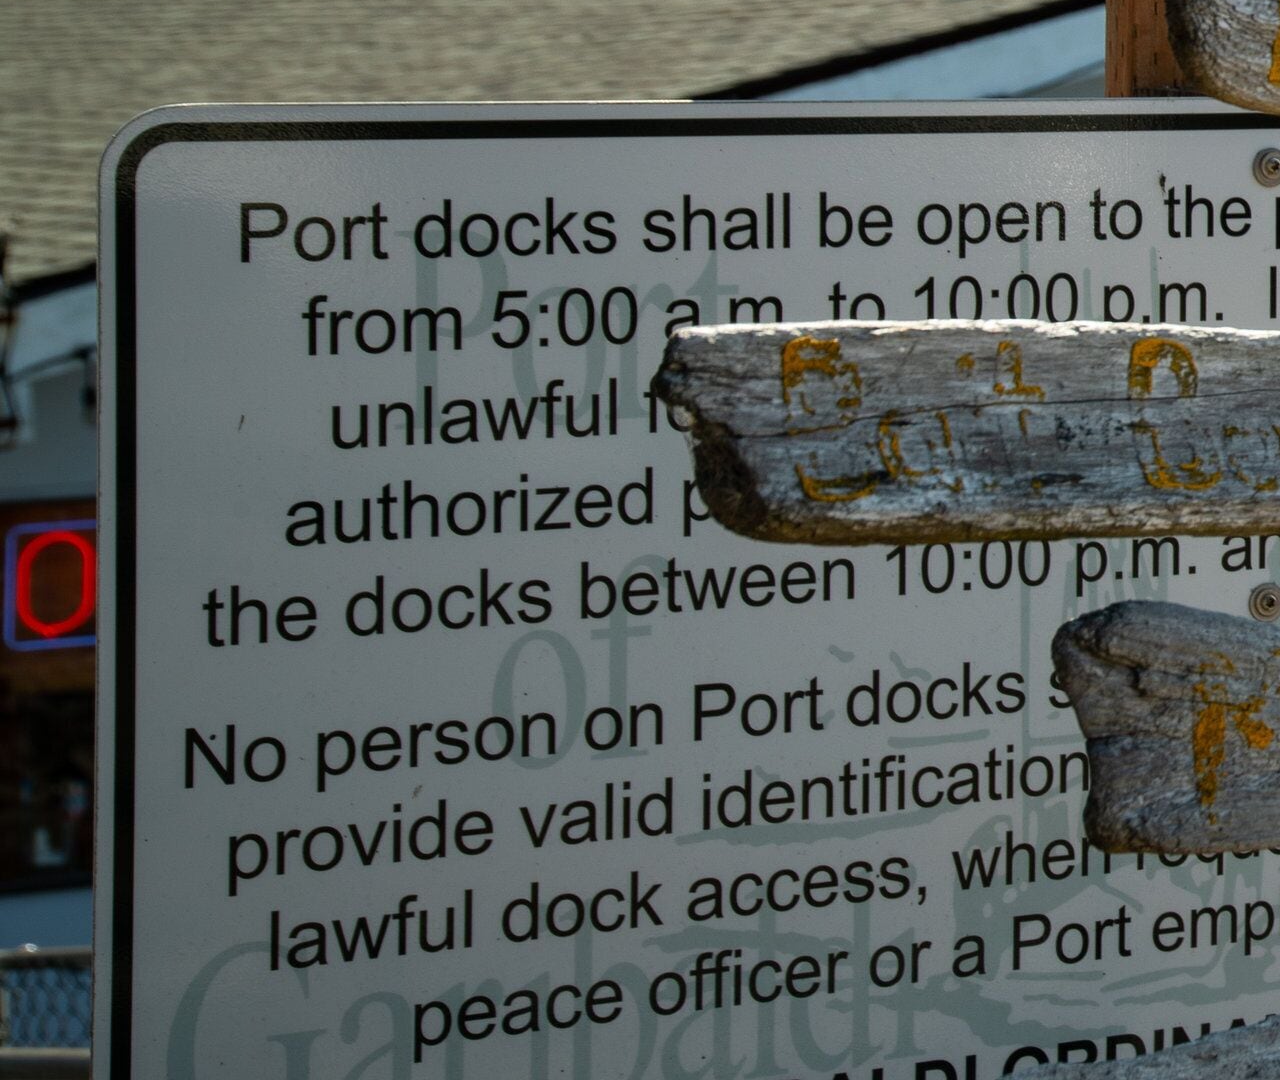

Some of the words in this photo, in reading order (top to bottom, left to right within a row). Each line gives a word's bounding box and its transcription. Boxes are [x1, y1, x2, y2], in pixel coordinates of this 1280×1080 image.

[240, 201, 389, 265] Port
[413, 197, 618, 260] docks
[642, 192, 792, 253] shall
[819, 191, 895, 248] be
[917, 200, 1067, 258] open
[1089, 189, 1144, 242] to
[1162, 183, 1253, 240] the
[302, 294, 464, 357] from
[491, 286, 639, 350] 5:00
[828, 281, 887, 322] to
[331, 378, 619, 450] unlawful
[285, 467, 654, 547] authorized
[202, 585, 318, 649] the
[345, 568, 553, 637] docks
[580, 557, 856, 620] between
[884, 541, 1053, 597] 10:00
[1075, 536, 1197, 598] p.m.
[184, 724, 288, 790] No
[316, 712, 558, 793] person
[584, 702, 665, 752] on
[693, 677, 826, 742] Port
[846, 662, 1027, 728] docks
[228, 799, 495, 898] provide
[519, 777, 674, 848] valid
[702, 745, 1090, 831] identification
[269, 889, 474, 972] lawful
[501, 870, 664, 943] dock
[687, 857, 928, 922] access,
[951, 830, 1112, 891] when
[413, 980, 624, 1064] peace
[648, 948, 850, 1017] officer
[869, 941, 933, 988] or
[952, 934, 987, 978] a
[1012, 906, 1133, 971] Port
